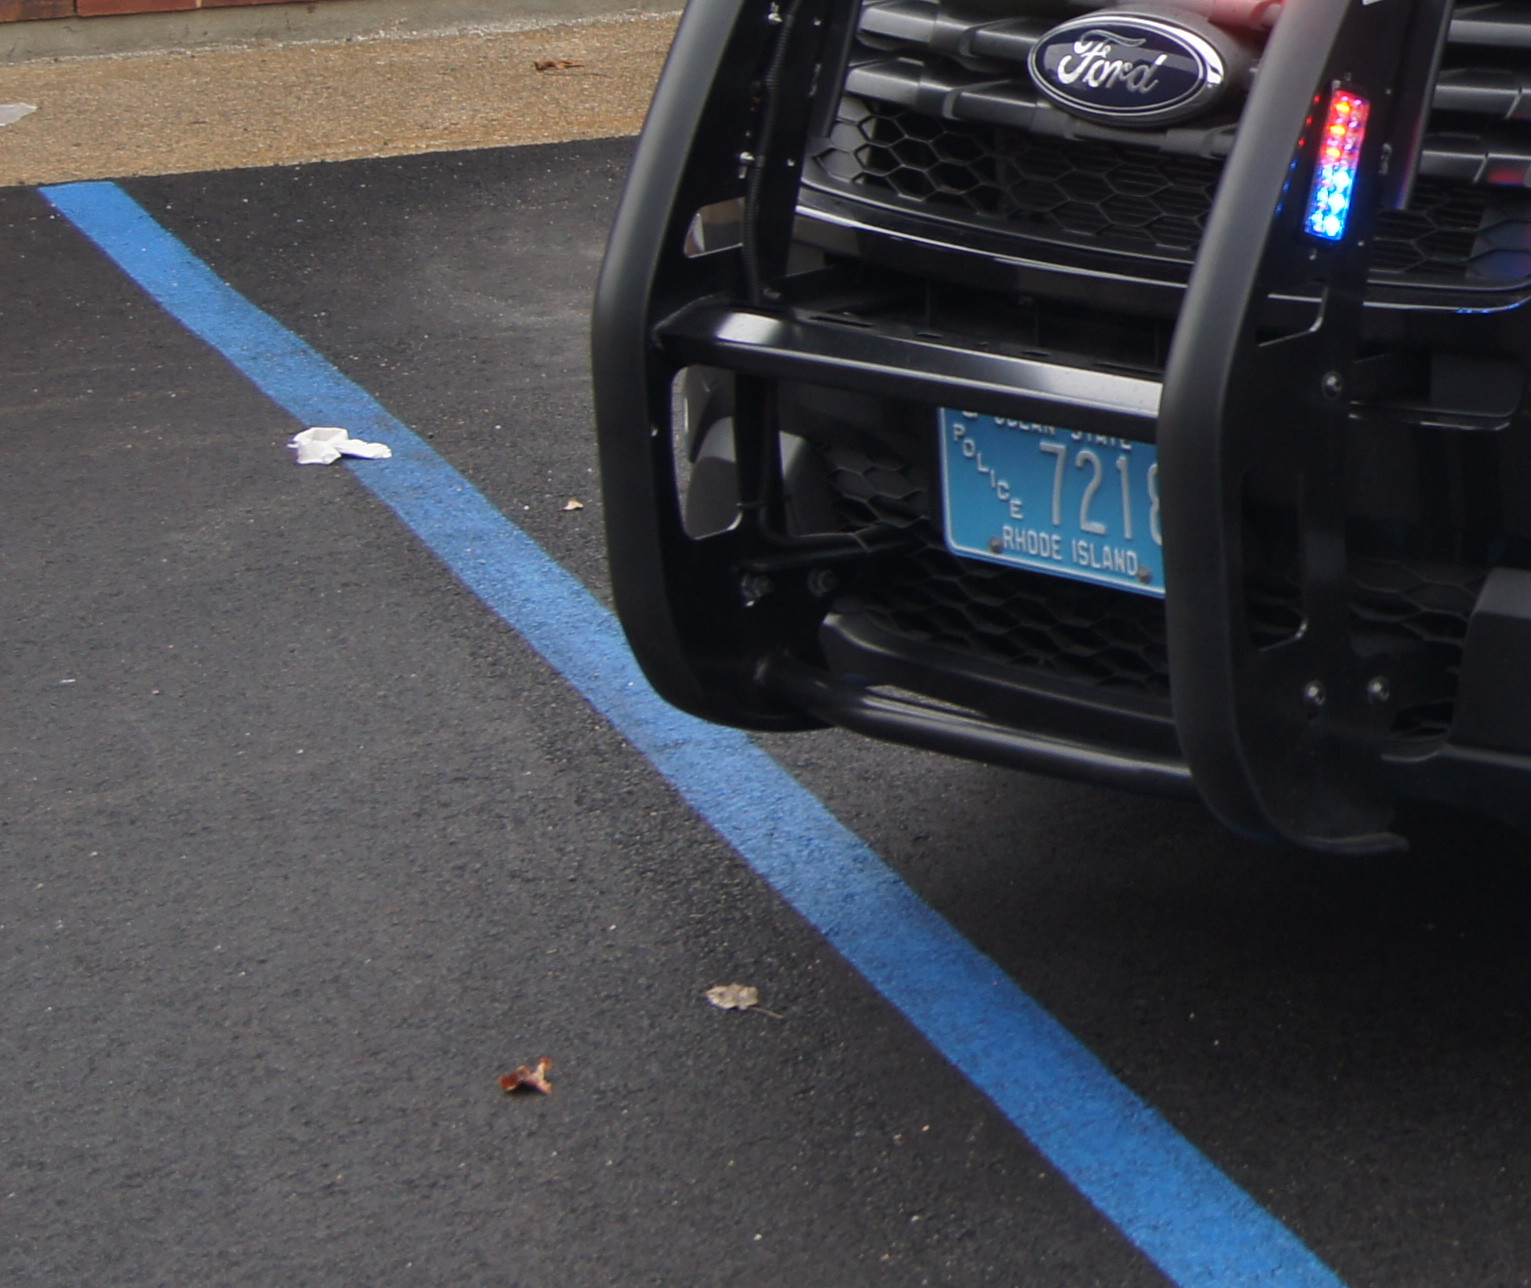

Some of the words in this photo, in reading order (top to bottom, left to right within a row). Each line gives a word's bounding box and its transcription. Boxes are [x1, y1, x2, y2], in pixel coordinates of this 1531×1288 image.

[1057, 30, 1168, 93] Ford
[952, 423, 1024, 520] POLICE
[1003, 525, 1063, 562] RHODE
[1071, 539, 1140, 577] ISLAND
